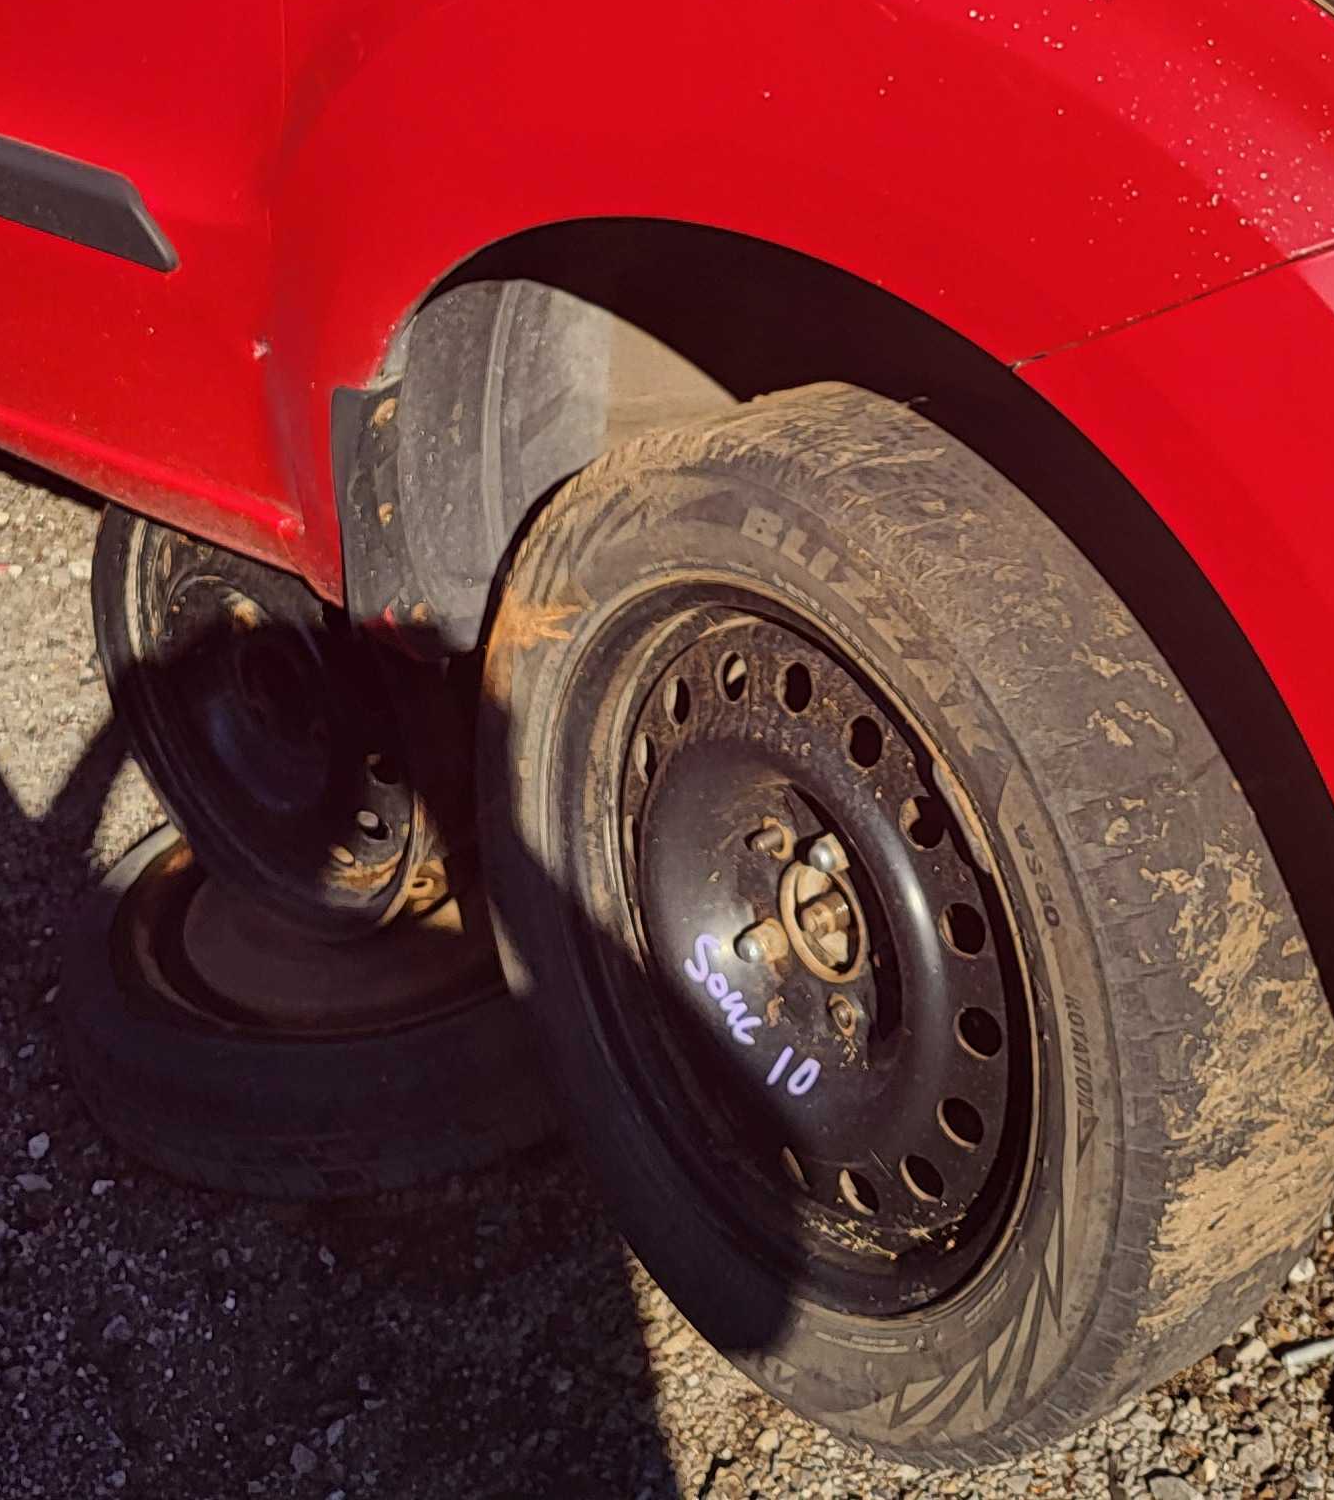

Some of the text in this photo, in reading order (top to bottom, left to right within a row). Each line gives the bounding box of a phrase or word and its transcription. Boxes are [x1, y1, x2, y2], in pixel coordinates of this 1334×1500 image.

[739, 505, 997, 758] BLIZZAK
[766, 1045, 821, 1096] 10
[1063, 992, 1095, 1111] ROTATION
